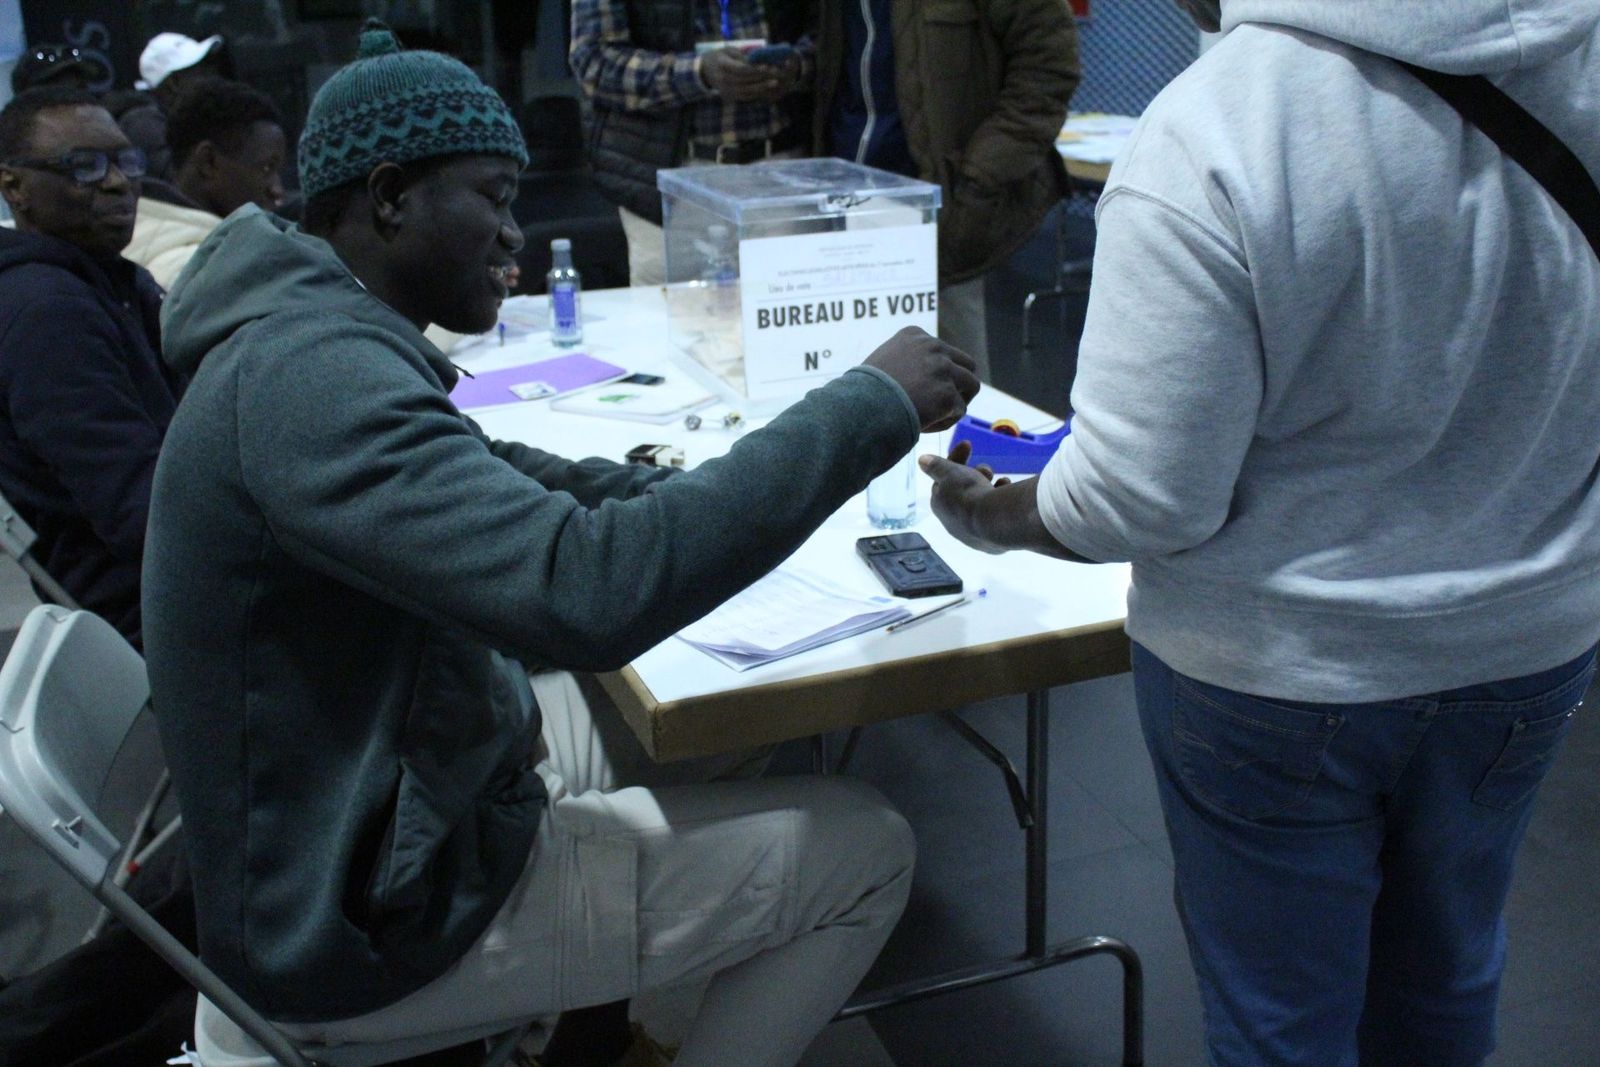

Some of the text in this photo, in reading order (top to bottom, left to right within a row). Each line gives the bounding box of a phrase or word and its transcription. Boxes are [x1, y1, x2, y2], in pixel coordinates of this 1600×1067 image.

[757, 291, 936, 329] BUREAU DE VOTE
[805, 349, 832, 371] N°
